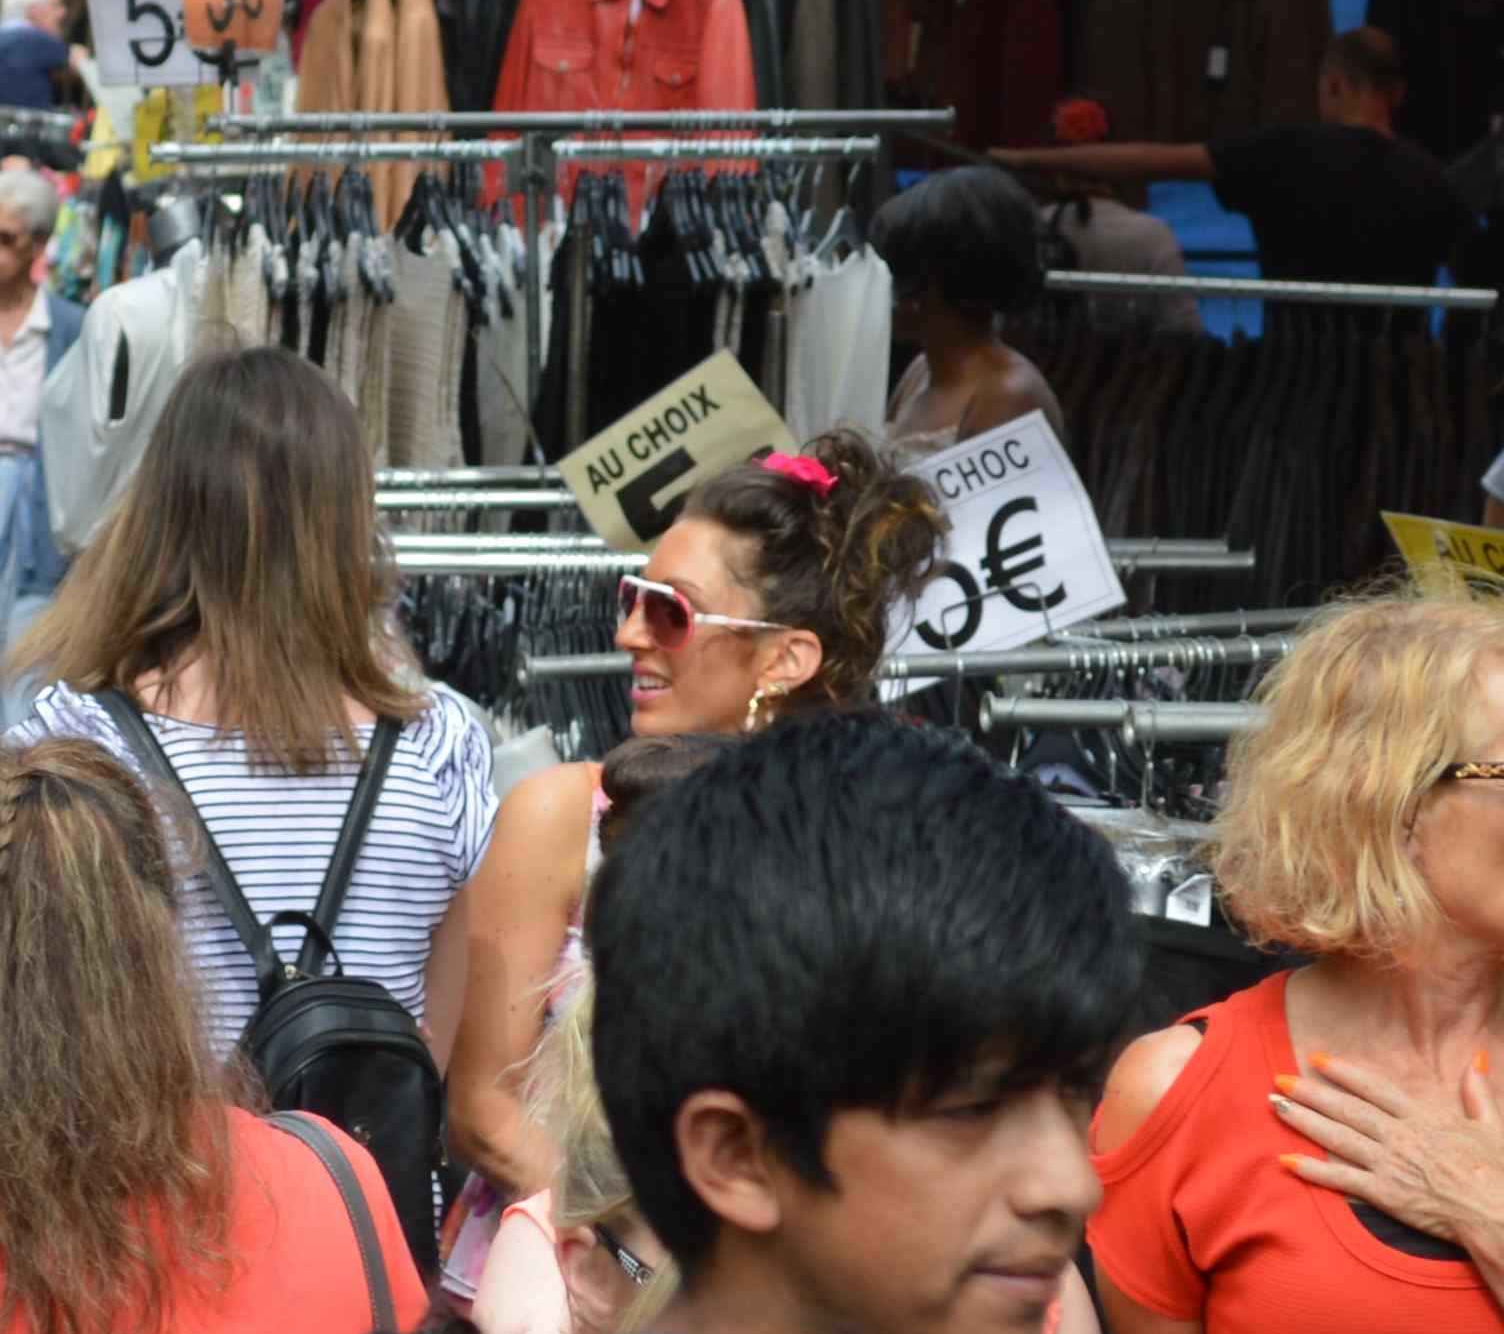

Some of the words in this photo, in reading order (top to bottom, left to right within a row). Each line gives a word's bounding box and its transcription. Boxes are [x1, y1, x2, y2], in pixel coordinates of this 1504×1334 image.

[586, 449, 625, 494] AU
[626, 384, 721, 460] CHOIX
[935, 439, 1030, 499] CHOC
